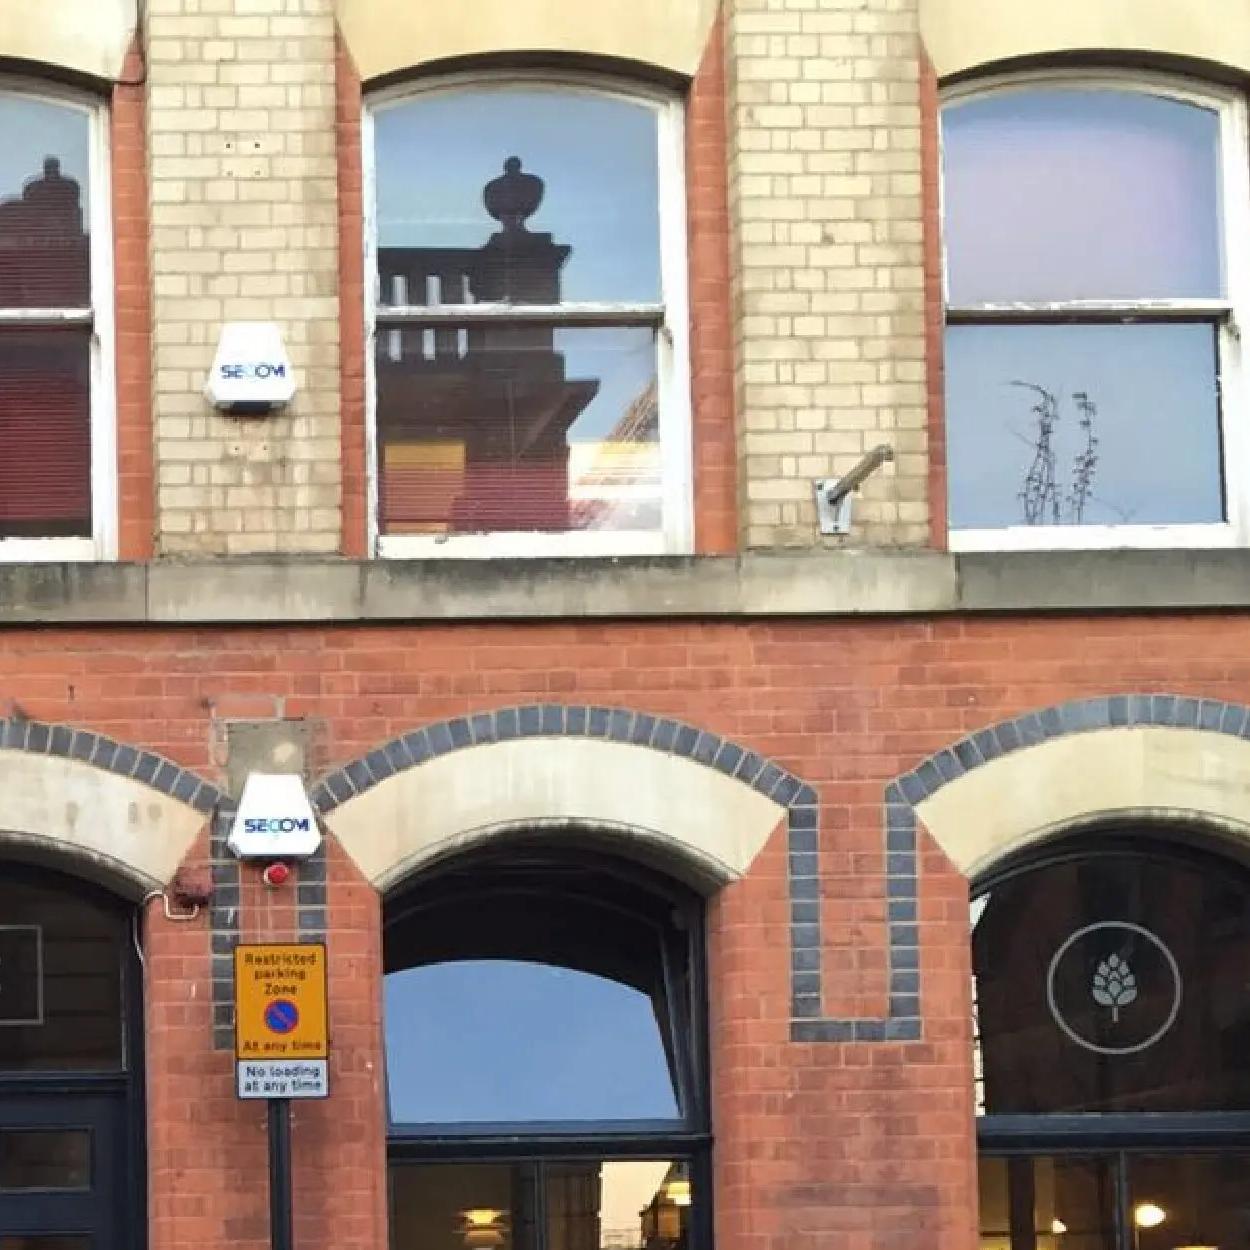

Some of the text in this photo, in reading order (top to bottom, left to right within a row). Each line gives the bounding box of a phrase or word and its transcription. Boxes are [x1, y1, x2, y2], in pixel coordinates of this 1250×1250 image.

[220, 363, 286, 379] SECOM
[244, 818, 310, 833] SECOM
[244, 952, 317, 967] Restricted
[264, 983, 298, 995] Zone
[243, 1038, 321, 1053] At any time
[246, 1065, 321, 1079] No loading
[245, 1079, 321, 1093] at any time
